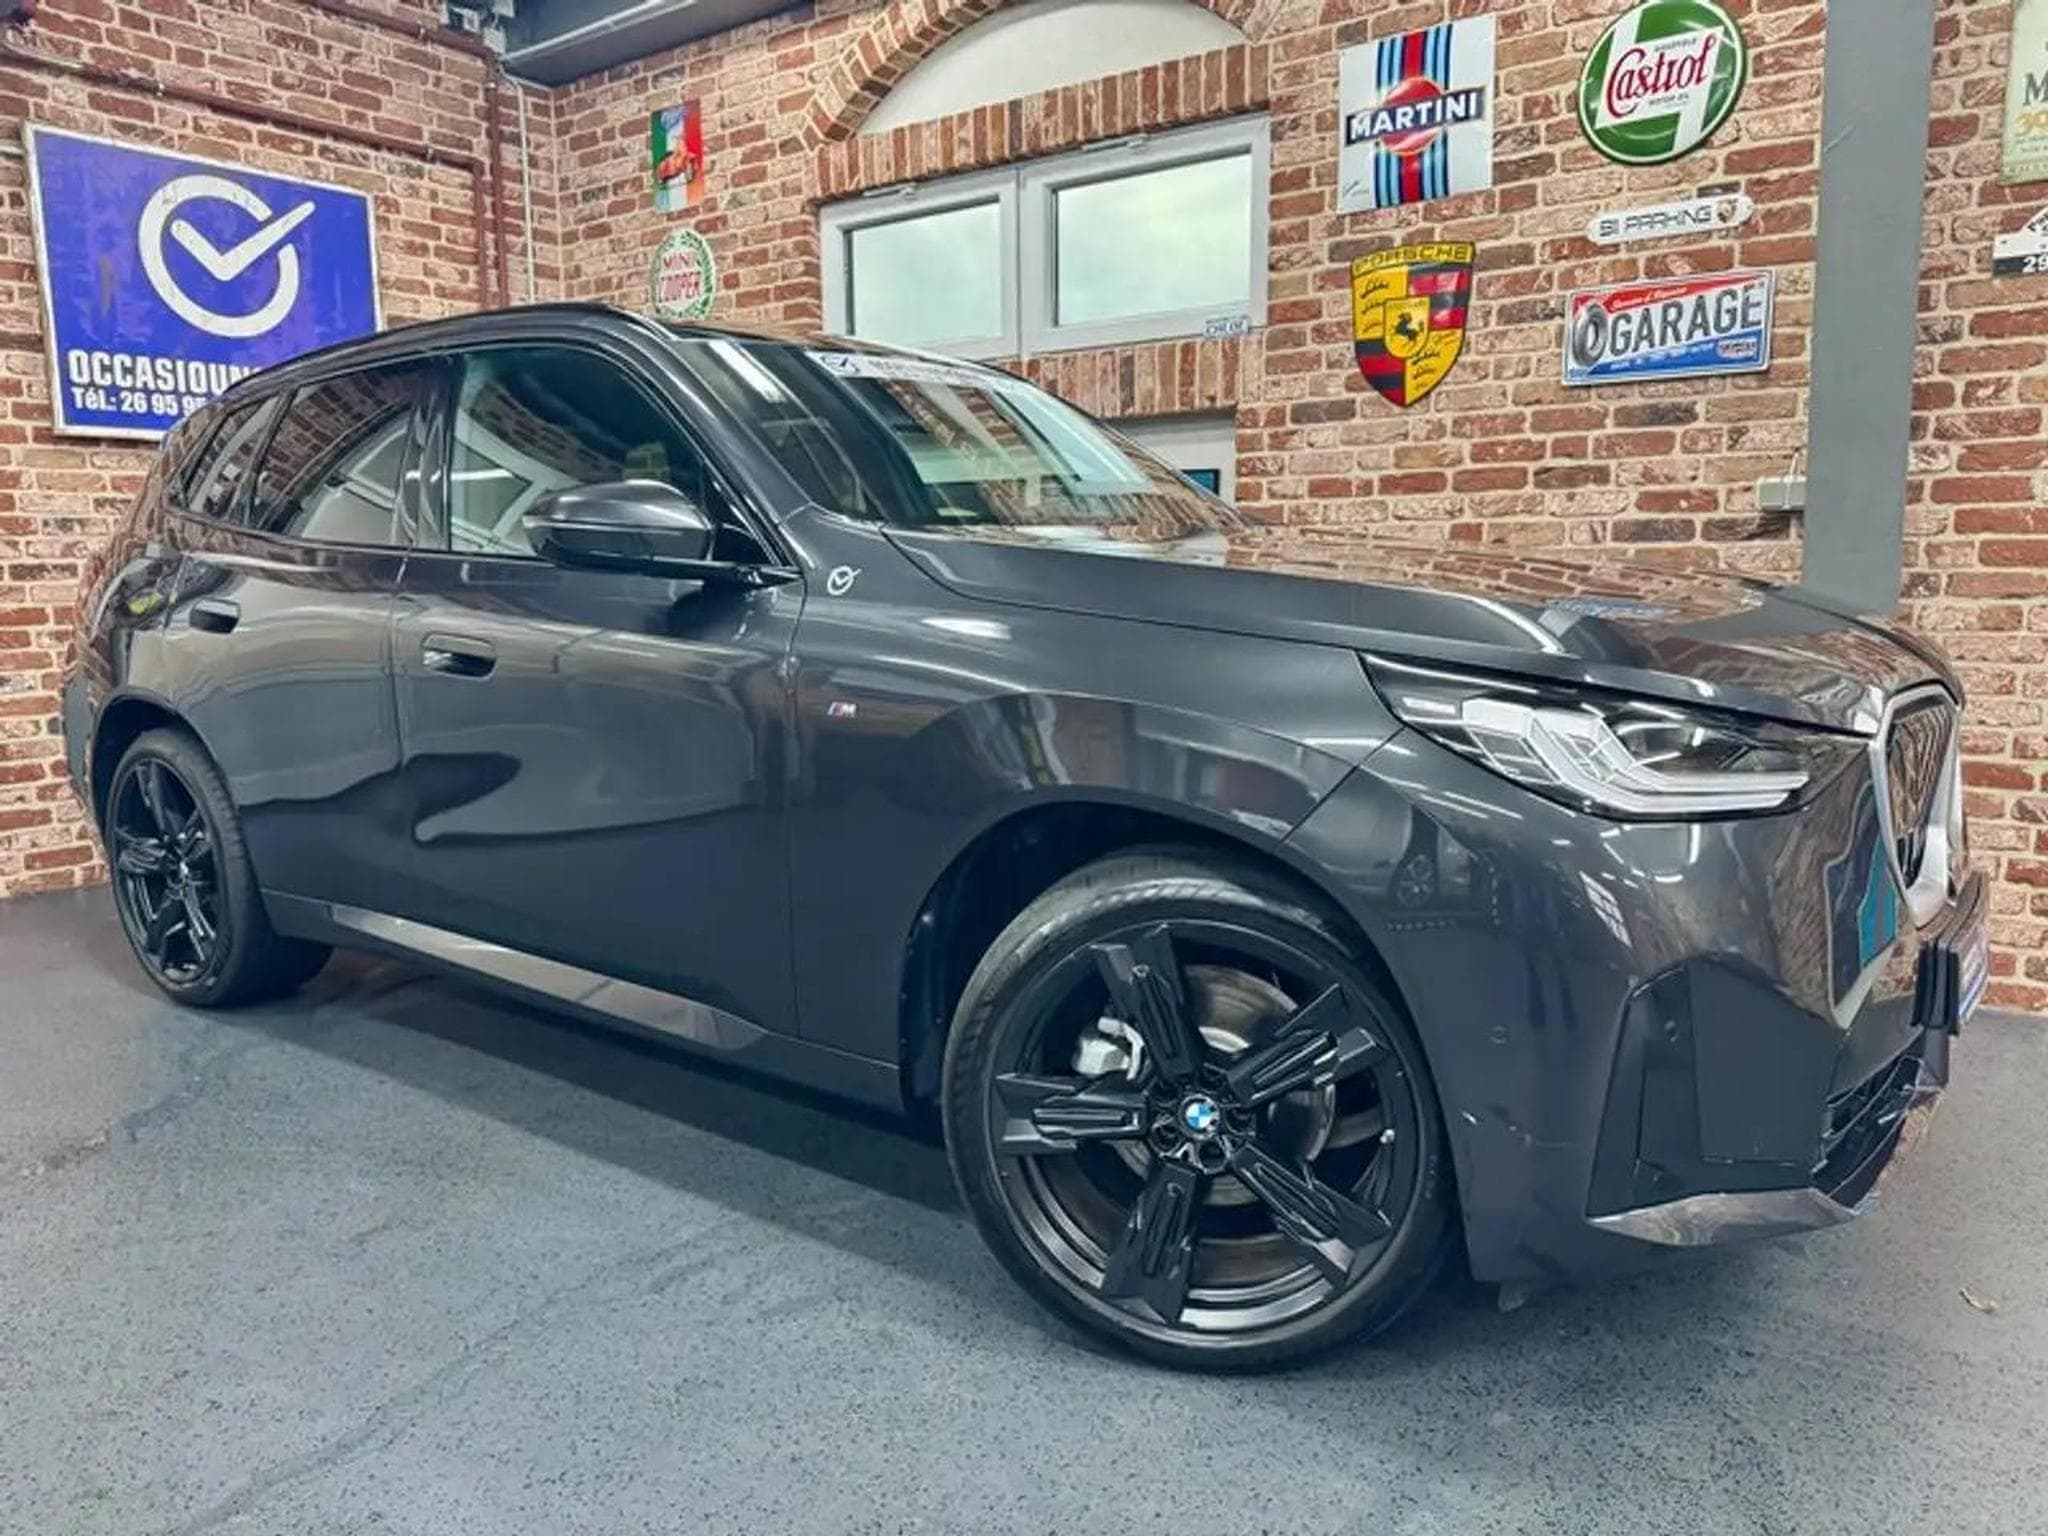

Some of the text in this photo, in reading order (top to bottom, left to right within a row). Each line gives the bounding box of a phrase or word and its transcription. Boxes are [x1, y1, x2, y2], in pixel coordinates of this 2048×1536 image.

[1607, 33, 1717, 118] Castrol
[1351, 92, 1477, 140] MARTINI
[1354, 246, 1468, 274] PORSCHE
[1611, 282, 1762, 357] GARAGE
[67, 349, 260, 396] OCCASIOUN
[120, 390, 147, 414] 26
[151, 393, 178, 417] 95
